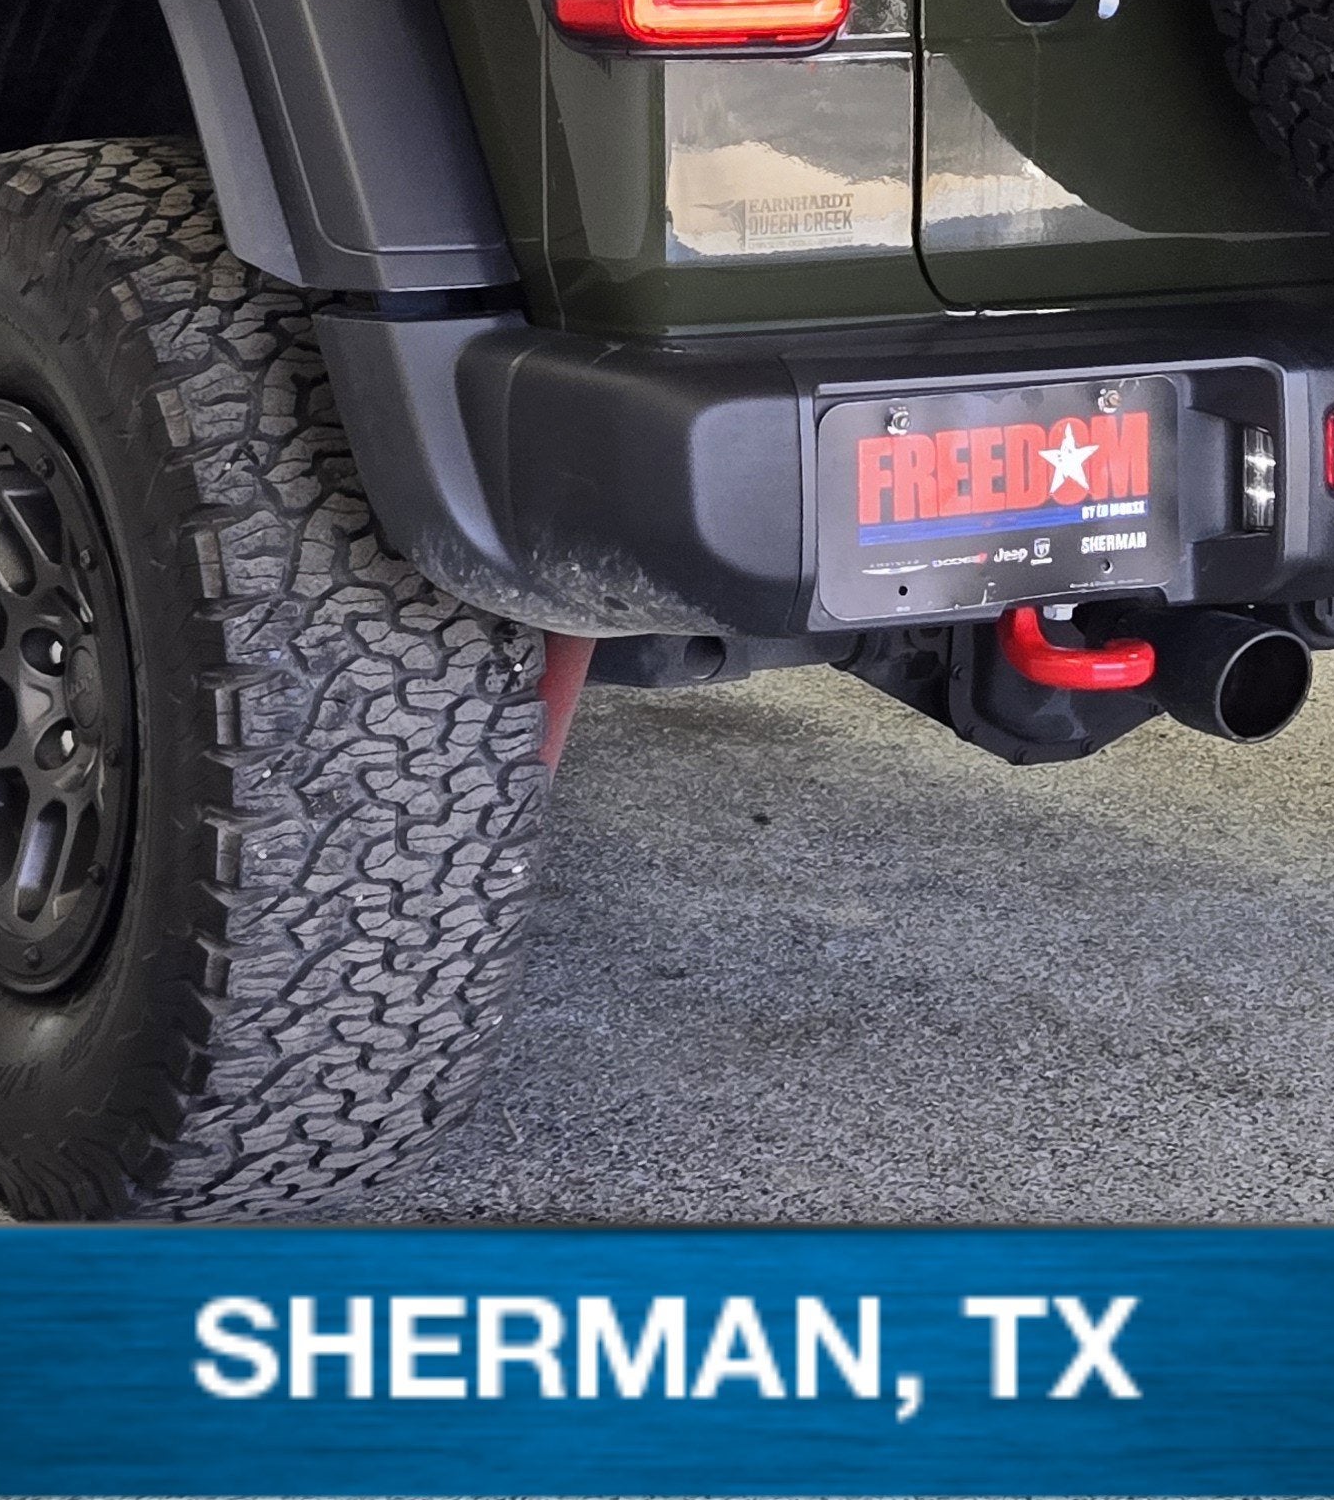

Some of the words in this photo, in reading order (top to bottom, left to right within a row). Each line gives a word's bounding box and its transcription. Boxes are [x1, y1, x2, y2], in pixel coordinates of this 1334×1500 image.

[748, 193, 855, 214] EARNHARDT
[748, 213, 799, 235] QUEEN
[802, 209, 854, 232] CREEK
[857, 411, 1150, 526] FREEDOM
[993, 548, 1028, 563] Jeep
[1080, 531, 1147, 554] SHERMAN
